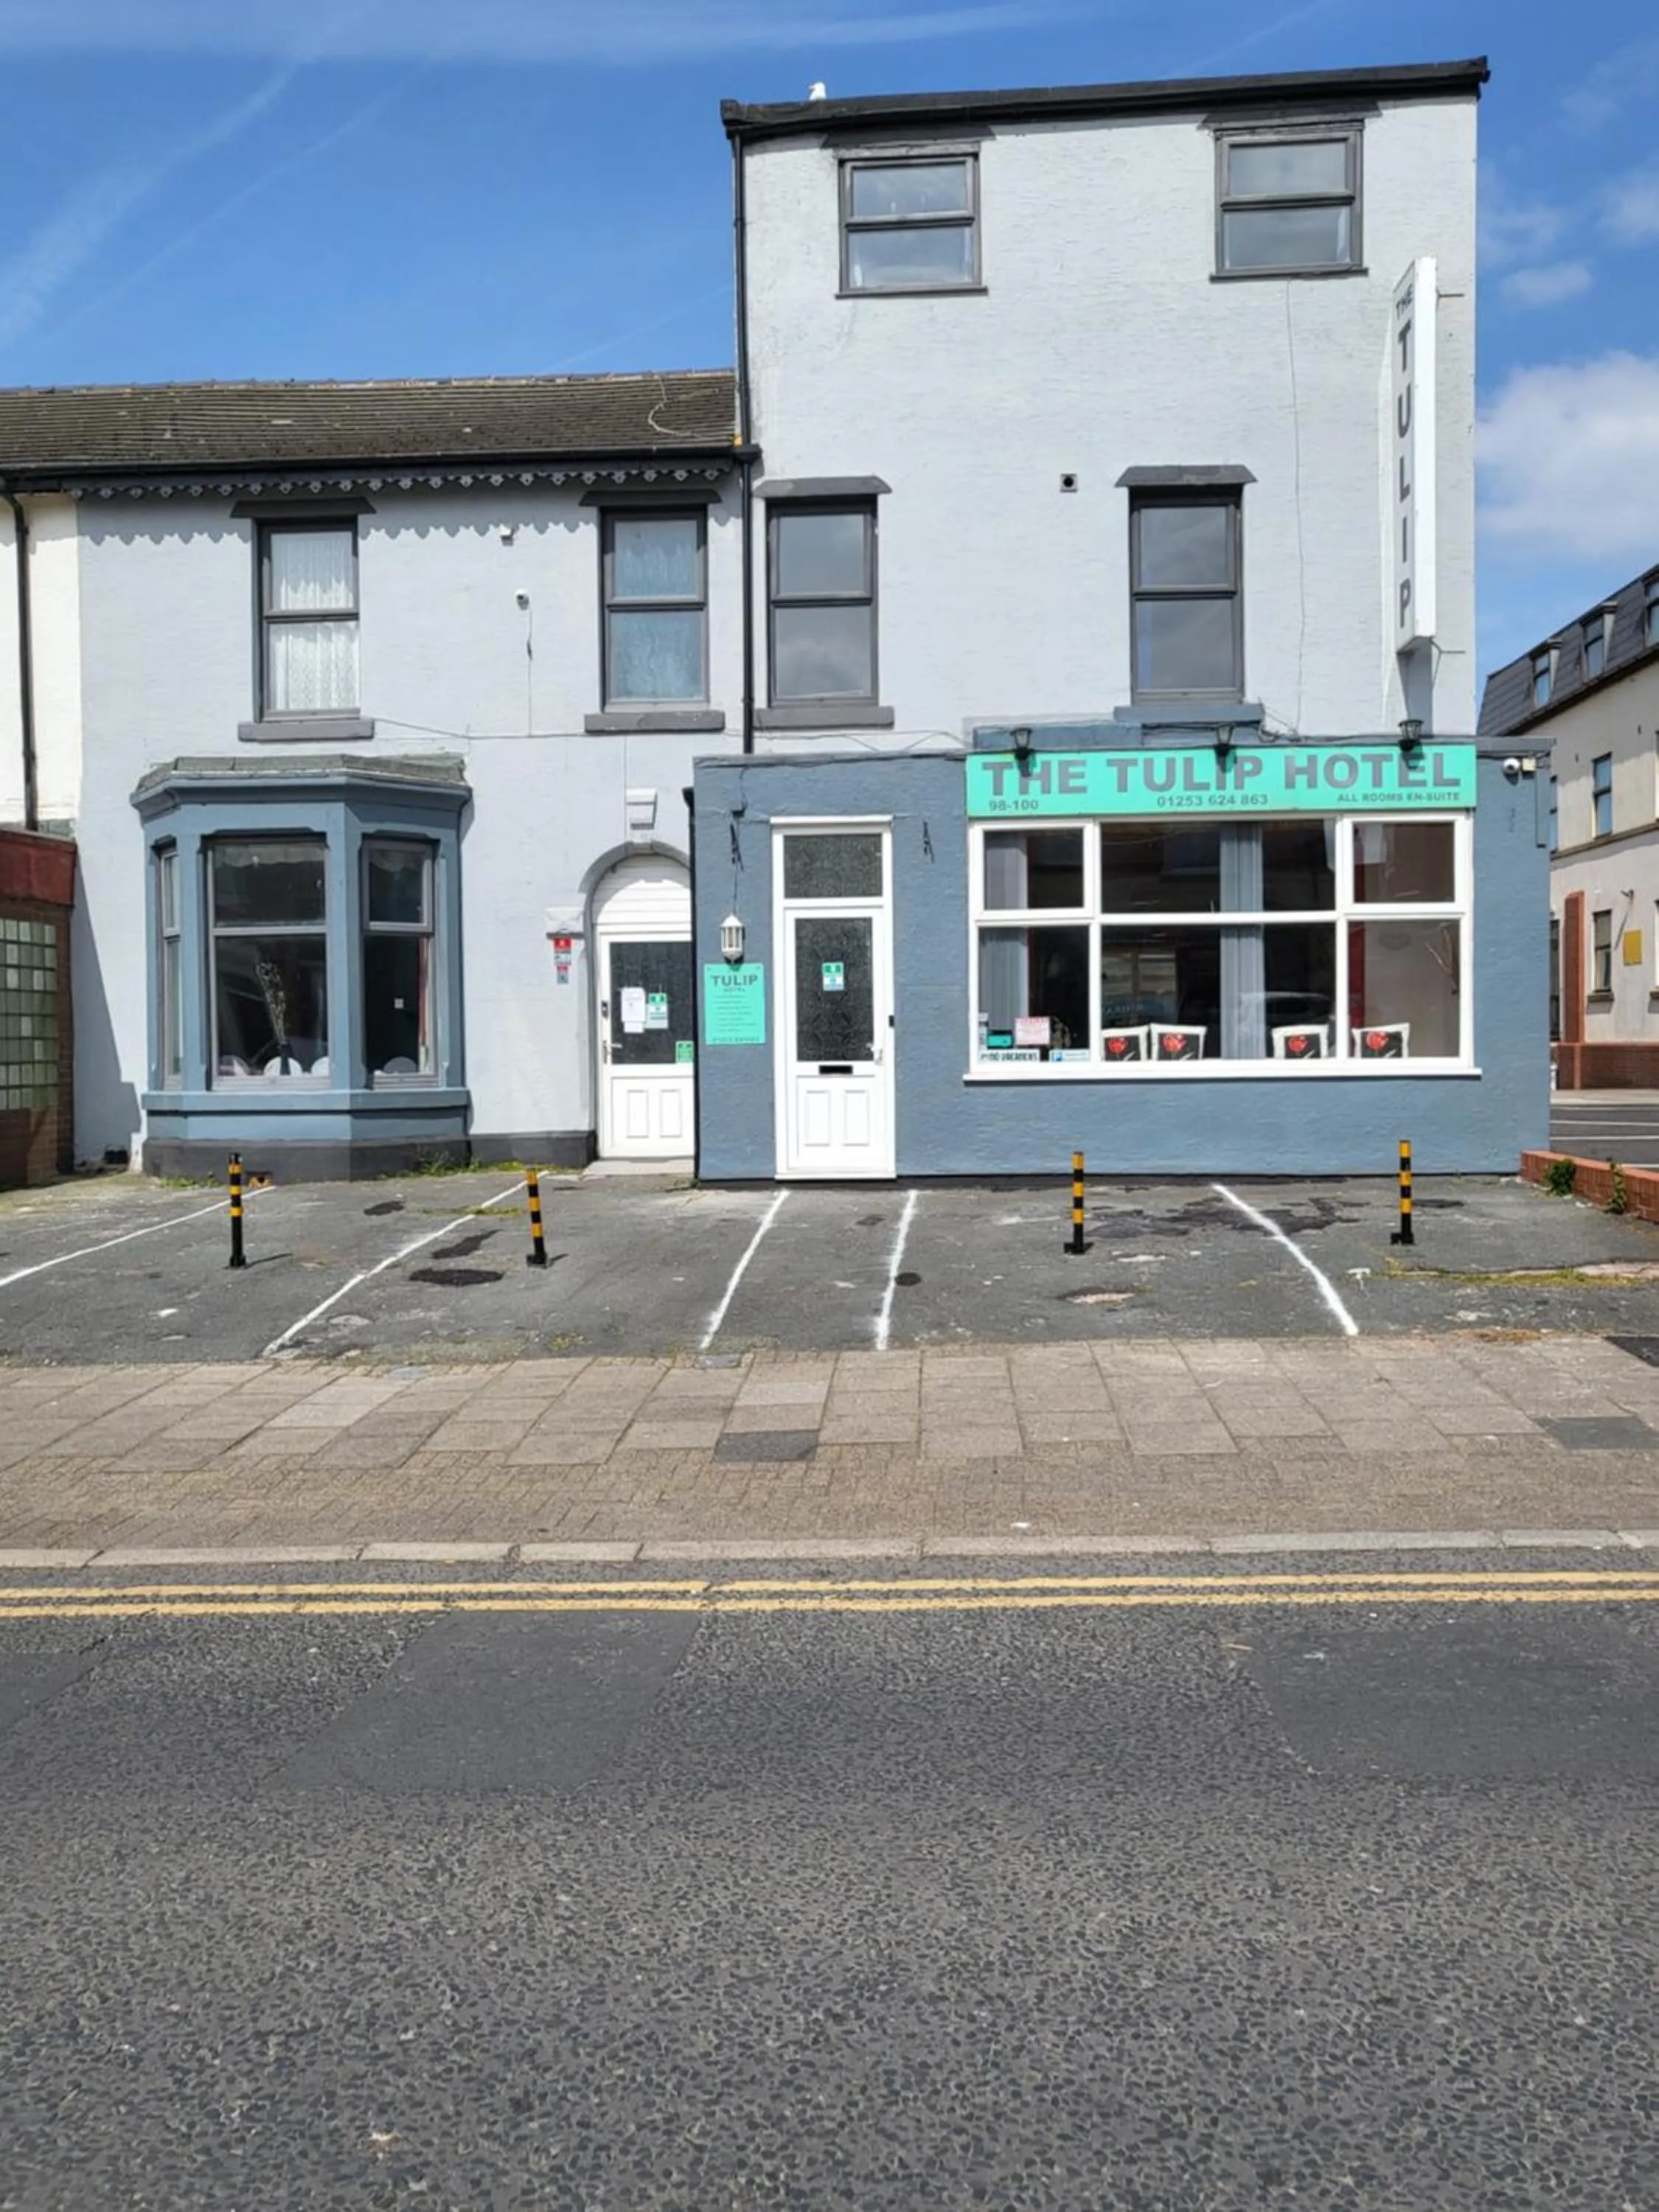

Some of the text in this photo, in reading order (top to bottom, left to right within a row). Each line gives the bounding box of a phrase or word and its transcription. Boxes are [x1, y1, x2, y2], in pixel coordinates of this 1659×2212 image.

[1396, 283, 1413, 320] THE
[1398, 319, 1412, 629] TULIP
[981, 752, 1461, 796] THE TULIP HOTEL
[1156, 793, 1268, 808] 01253 624 863
[1337, 791, 1460, 803] ALL ROOMS EN-SUITE
[989, 799, 1039, 811] 98-100
[710, 974, 759, 987] TULIP
